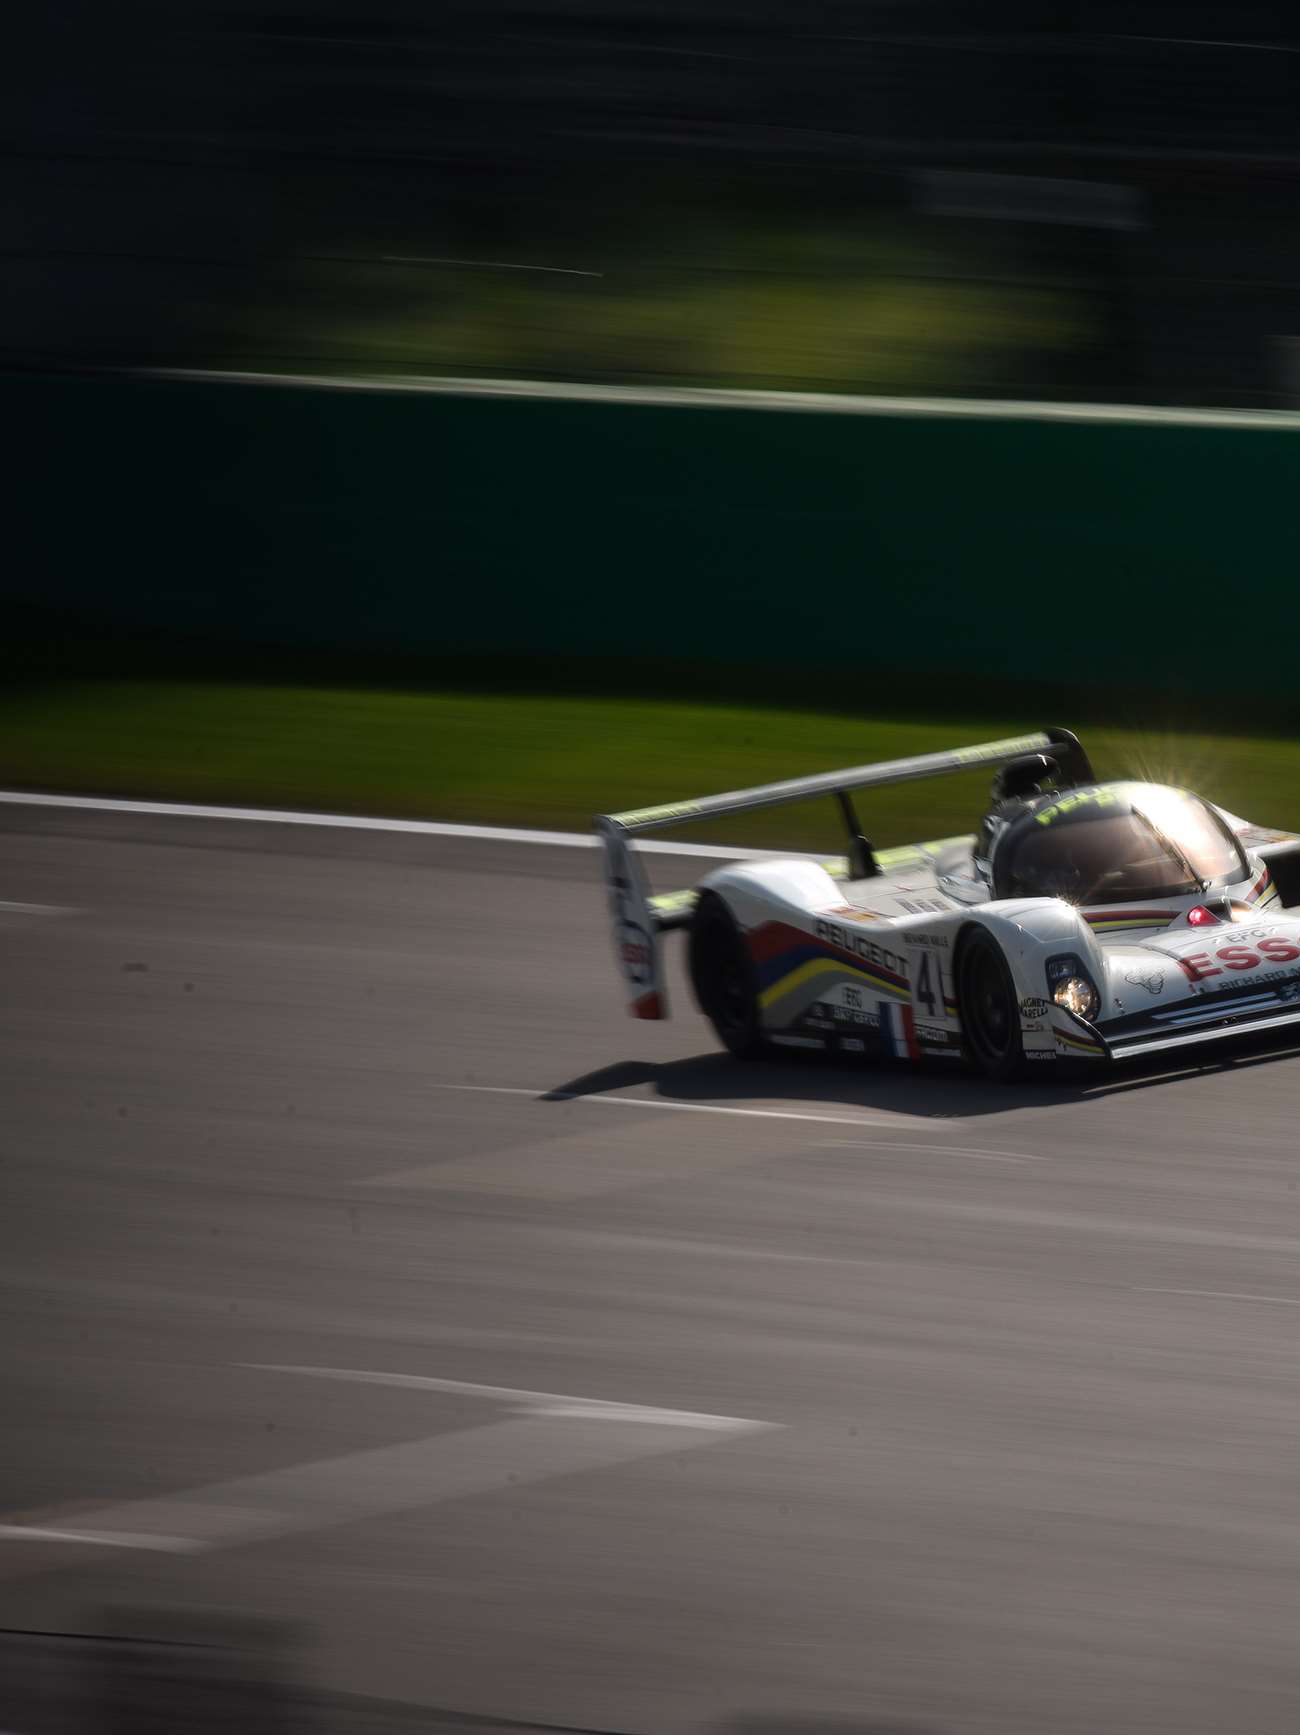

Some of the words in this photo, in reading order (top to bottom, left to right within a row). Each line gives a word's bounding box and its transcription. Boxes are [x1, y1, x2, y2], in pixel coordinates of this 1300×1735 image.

[1226, 929, 1266, 944] EFG
[815, 918, 909, 977] PEUGEOT
[1218, 971, 1287, 992] RICHARD
